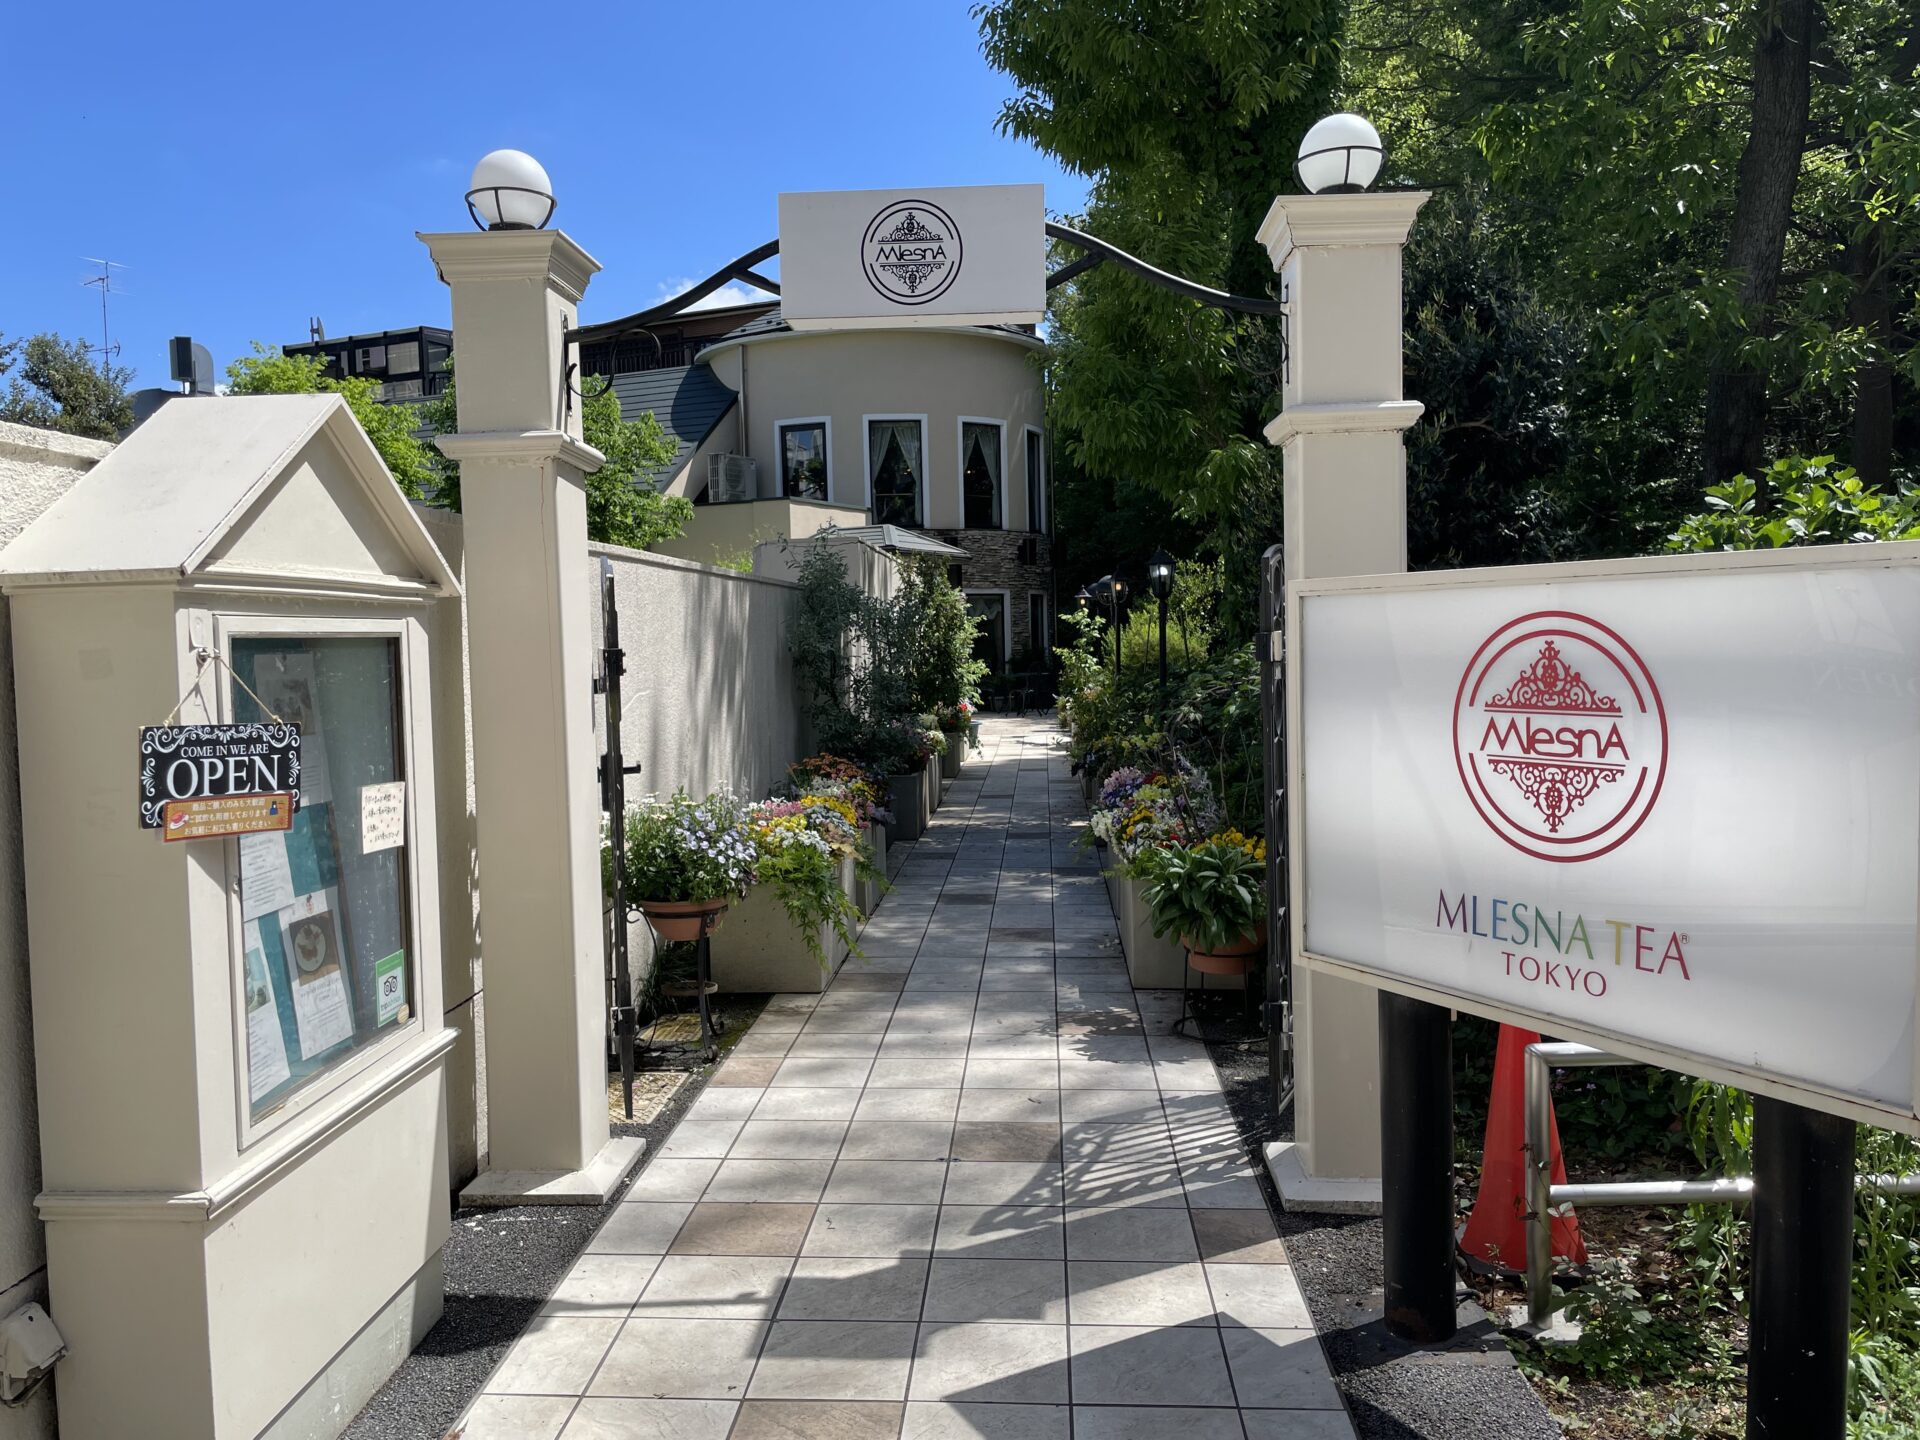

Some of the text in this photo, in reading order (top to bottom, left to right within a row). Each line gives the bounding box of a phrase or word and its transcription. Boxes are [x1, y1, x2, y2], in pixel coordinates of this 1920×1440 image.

[181, 743, 270, 758] COME IN WE ARE
[166, 755, 281, 799] OPEN
[1436, 889, 1594, 960] MLESNA
[1501, 951, 1607, 998] TOKYO
